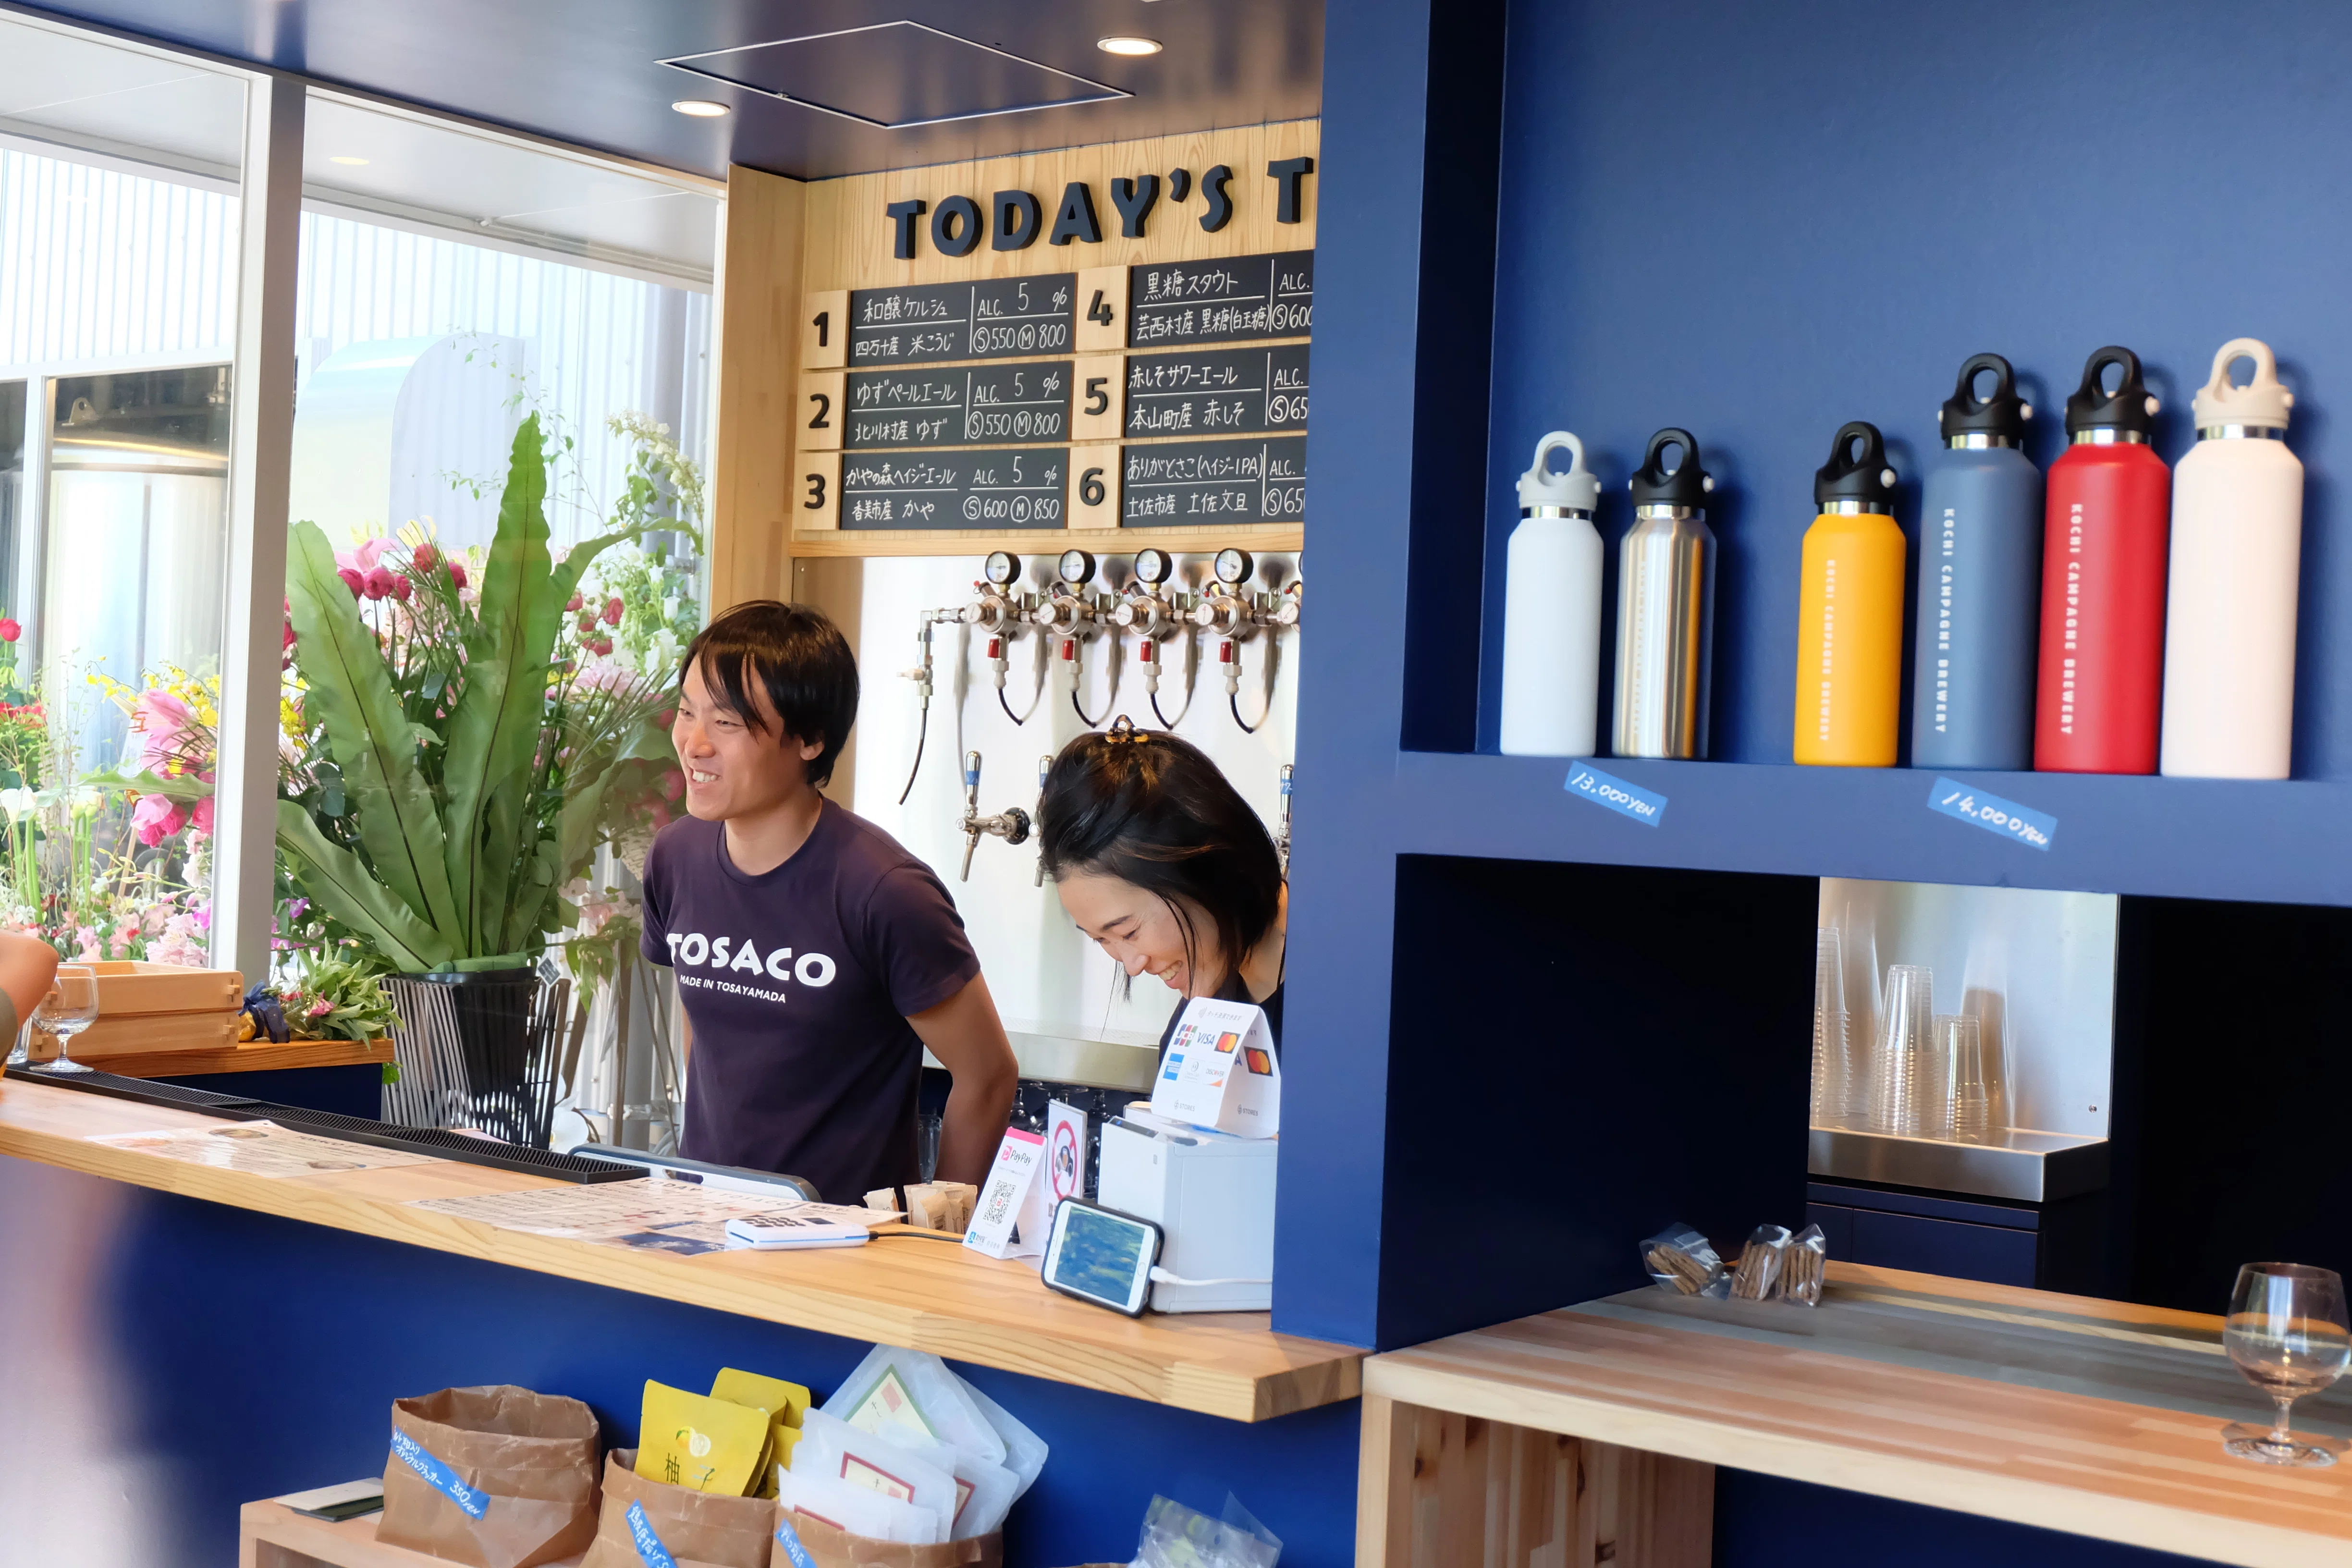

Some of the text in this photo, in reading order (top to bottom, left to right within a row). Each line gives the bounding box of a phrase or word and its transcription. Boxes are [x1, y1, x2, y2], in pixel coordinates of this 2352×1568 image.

[886, 164, 1233, 260] TODAY'S
[1144, 269, 1239, 301] 黒糖スタウト
[1279, 272, 1310, 291] ALC.
[977, 282, 1067, 317] ALC. 5 %
[1087, 289, 1113, 326] 4
[812, 311, 829, 347] 1
[991, 327, 1016, 351] 550
[1038, 323, 1066, 349] 800
[1136, 309, 1194, 340] 芸西村産
[855, 332, 955, 357] 四万十産 米こうじ
[974, 371, 1060, 404] ALC. 5 %
[1128, 364, 1238, 388] 赤しそサワーエール
[1274, 368, 1304, 386] ALC.
[857, 378, 956, 406] ゆずペールエール
[1083, 377, 1109, 416] 5
[808, 393, 830, 429] 2
[1129, 398, 1245, 430] 本山町産 赤しそ
[1290, 396, 1309, 419] 65
[855, 417, 948, 441] 北川村産 ゆず
[985, 413, 1011, 436] 550
[1033, 413, 1061, 435] 800
[845, 462, 956, 488] かやの森ヘイジーエール
[973, 456, 1057, 486] ALC. 5 %
[1270, 459, 1296, 477] ALC.
[803, 473, 826, 509] 3
[1078, 467, 1105, 506] 6
[1284, 487, 1305, 513] 65
[852, 500, 935, 521] 香美市産 かや
[983, 500, 1008, 518] 600
[1033, 498, 1060, 519] 850
[1126, 489, 1249, 518] 土佐市産 土佐文旦
[1935, 508, 1955, 733] KOCHI CAMPAGNE BREWERY
[2061, 503, 2083, 734] KOCHI CAMPAGNE BREWERY
[666, 932, 836, 987] TOSACO
[680, 974, 786, 1004] MADE IN TOSAYAMADA
[1197, 1032, 1216, 1045] VISA
[1179, 1102, 1195, 1112] STORES
[1242, 1108, 1259, 1116] STORES
[1010, 1150, 1032, 1166] PayPay
